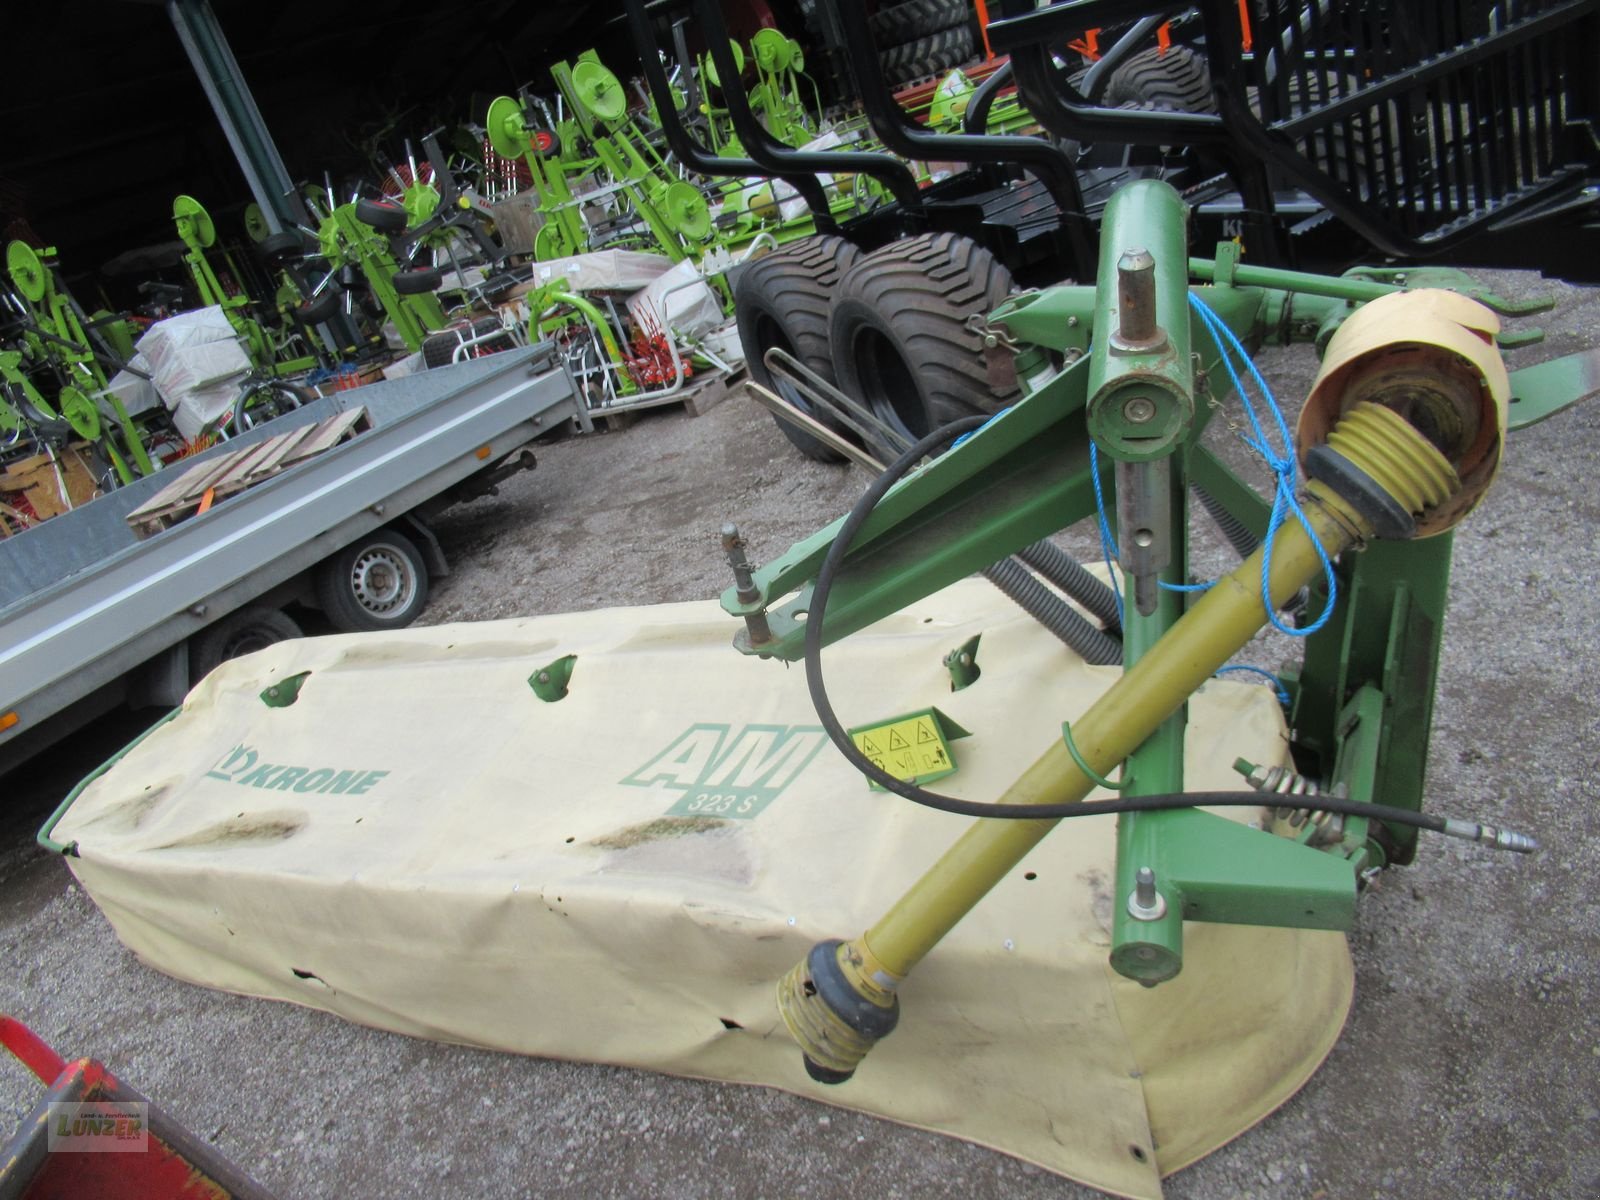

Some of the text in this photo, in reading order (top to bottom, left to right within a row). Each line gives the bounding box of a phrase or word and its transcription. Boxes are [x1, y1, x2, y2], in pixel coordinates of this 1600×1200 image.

[618, 723, 828, 791] AM
[237, 763, 391, 795] KRONE
[687, 793, 758, 813] 323 S
